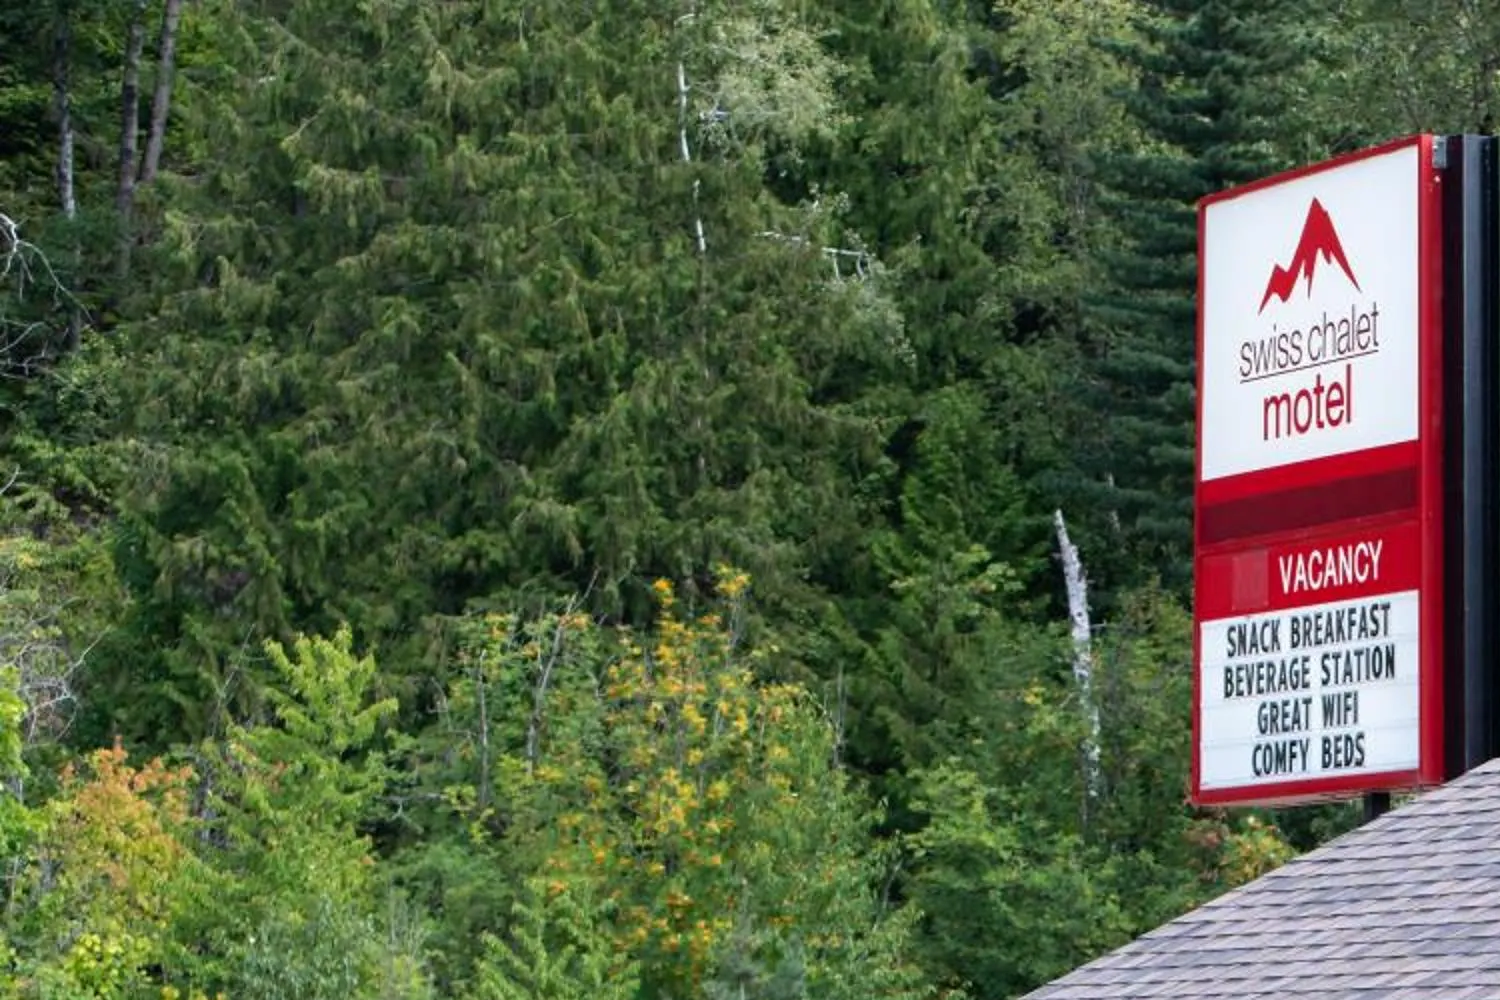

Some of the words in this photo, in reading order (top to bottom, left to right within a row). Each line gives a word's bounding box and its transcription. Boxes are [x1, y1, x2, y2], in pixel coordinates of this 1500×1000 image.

[1240, 323, 1302, 377] swiss
[1308, 302, 1379, 361] chalet
[1263, 363, 1351, 441] motel
[1279, 540, 1382, 594] VACANCY
[1227, 618, 1280, 657] SNACK
[1291, 602, 1390, 648] BREAKFAST
[1224, 656, 1310, 697] BEVERAGE
[1321, 644, 1395, 686] STATION
[1257, 697, 1312, 734] GREAT
[1322, 691, 1359, 727] WIFI
[1252, 738, 1309, 776] COMFY
[1321, 732, 1365, 768] BEDS
